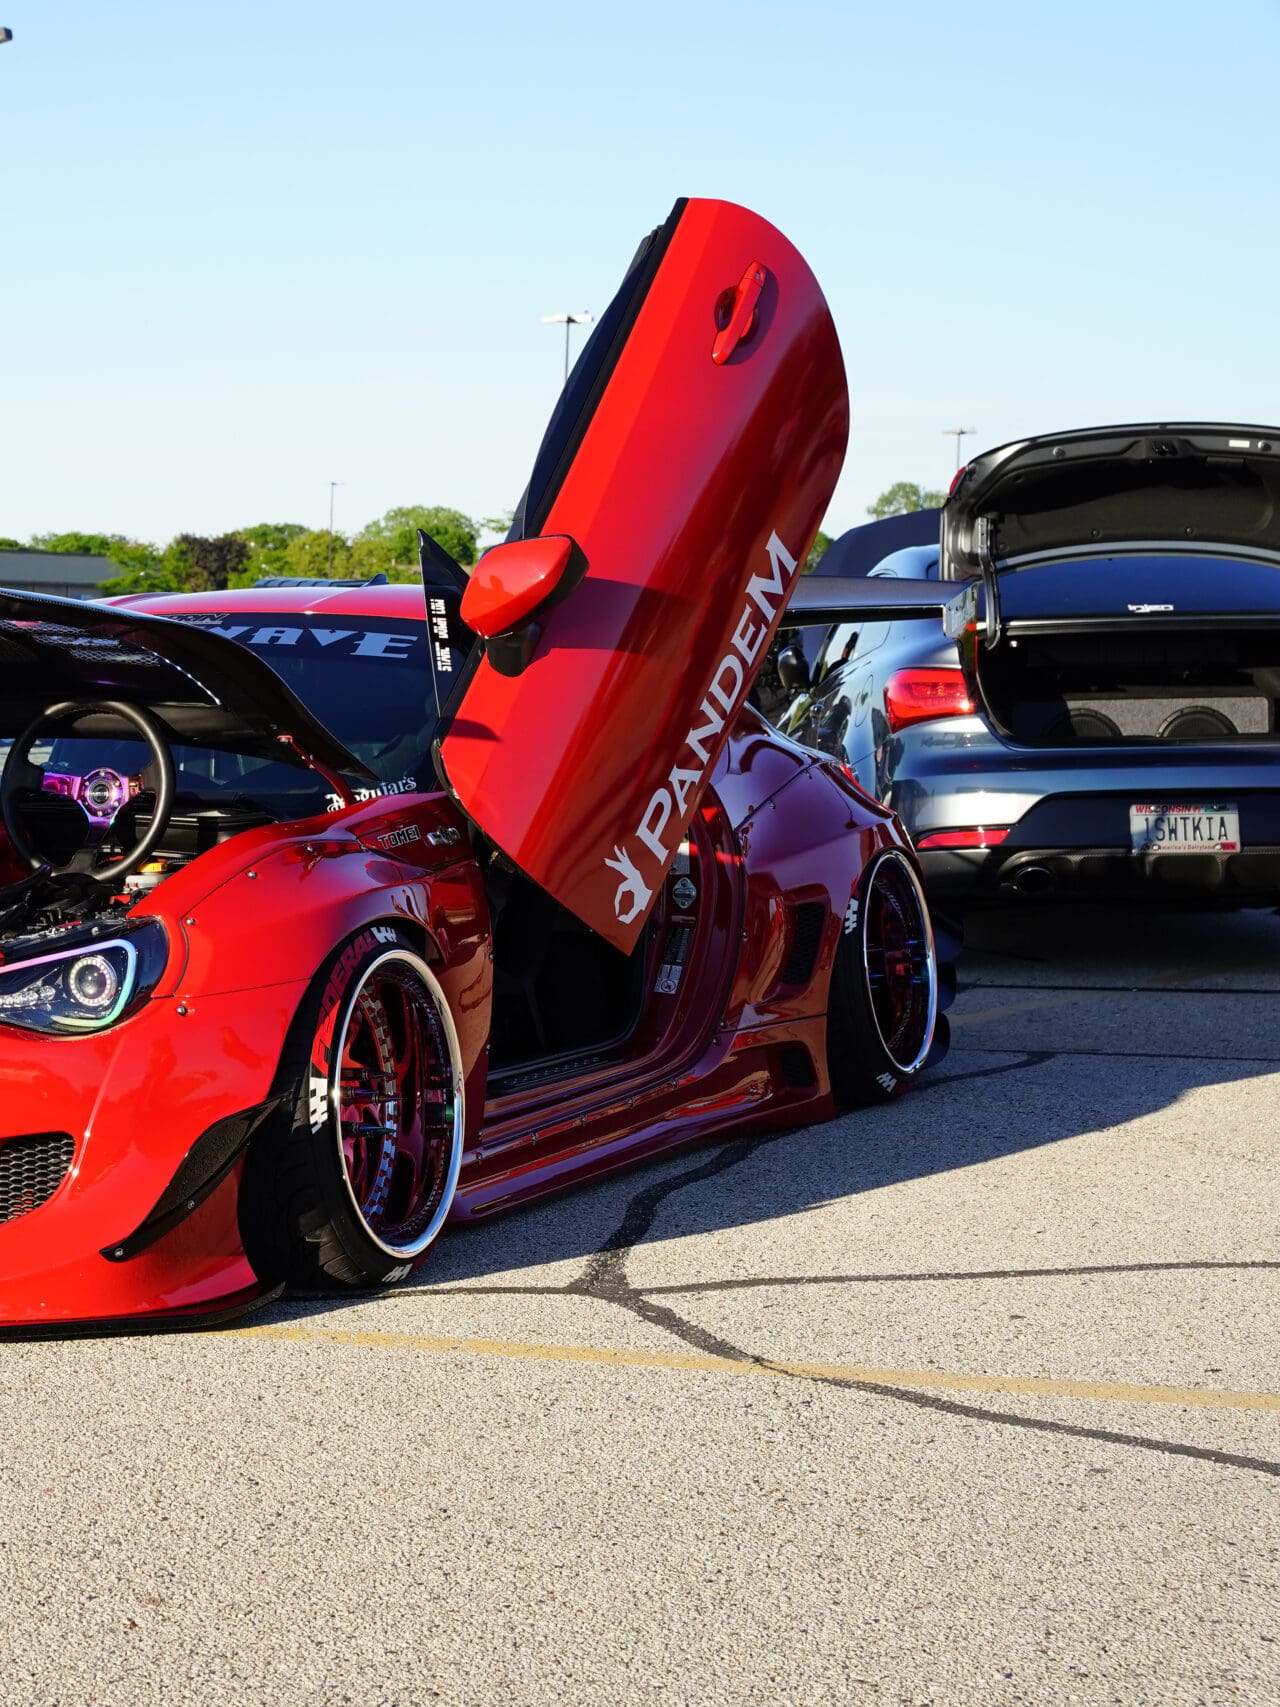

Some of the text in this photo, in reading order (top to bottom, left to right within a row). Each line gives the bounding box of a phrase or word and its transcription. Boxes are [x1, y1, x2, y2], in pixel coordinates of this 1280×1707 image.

[636, 529, 798, 865] PANDEM
[377, 825, 421, 850] TOMEI
[1144, 816, 1228, 841] 1SWTKIA
[311, 930, 380, 1077] FEDERAL
